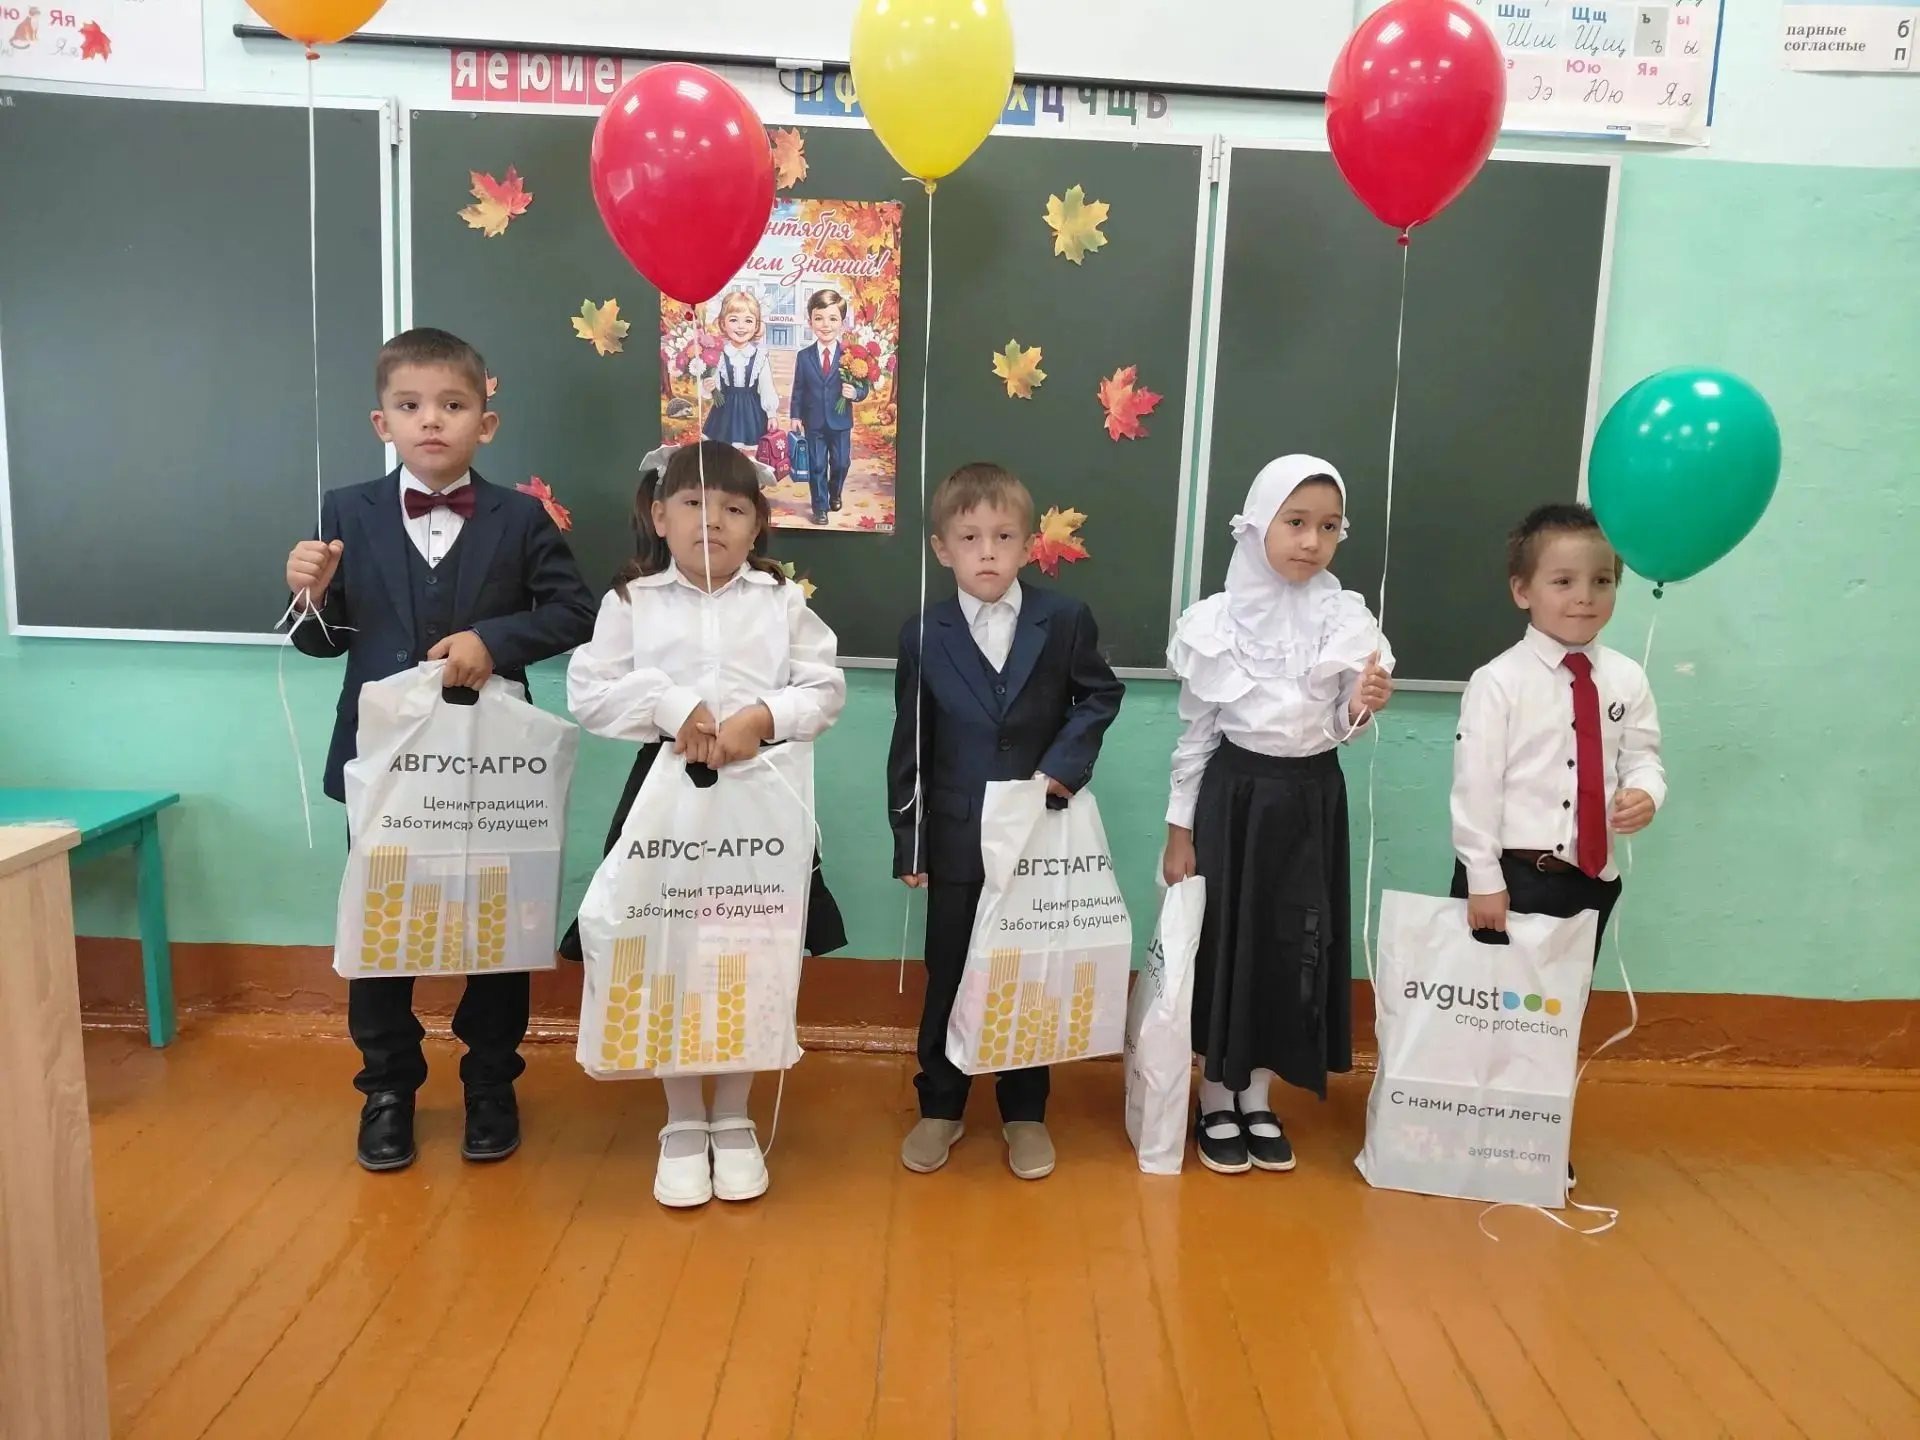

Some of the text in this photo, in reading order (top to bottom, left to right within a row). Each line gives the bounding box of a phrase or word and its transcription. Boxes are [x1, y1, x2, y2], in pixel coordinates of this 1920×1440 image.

[49, 9, 76, 27] Яя
[1786, 25, 1847, 38] парные
[1784, 41, 1866, 52] согласные
[764, 209, 854, 251] нтября
[780, 249, 891, 286] Знаний!
[478, 816, 548, 832] будущем
[707, 883, 785, 899] традиции.
[702, 907, 712, 917] о
[716, 902, 784, 919] будущем
[1404, 980, 1500, 1011] avgust
[1455, 1012, 1568, 1038] crop protection
[1391, 1091, 1562, 1124] С нами расти легче
[1468, 1145, 1551, 1164] avgust.com
